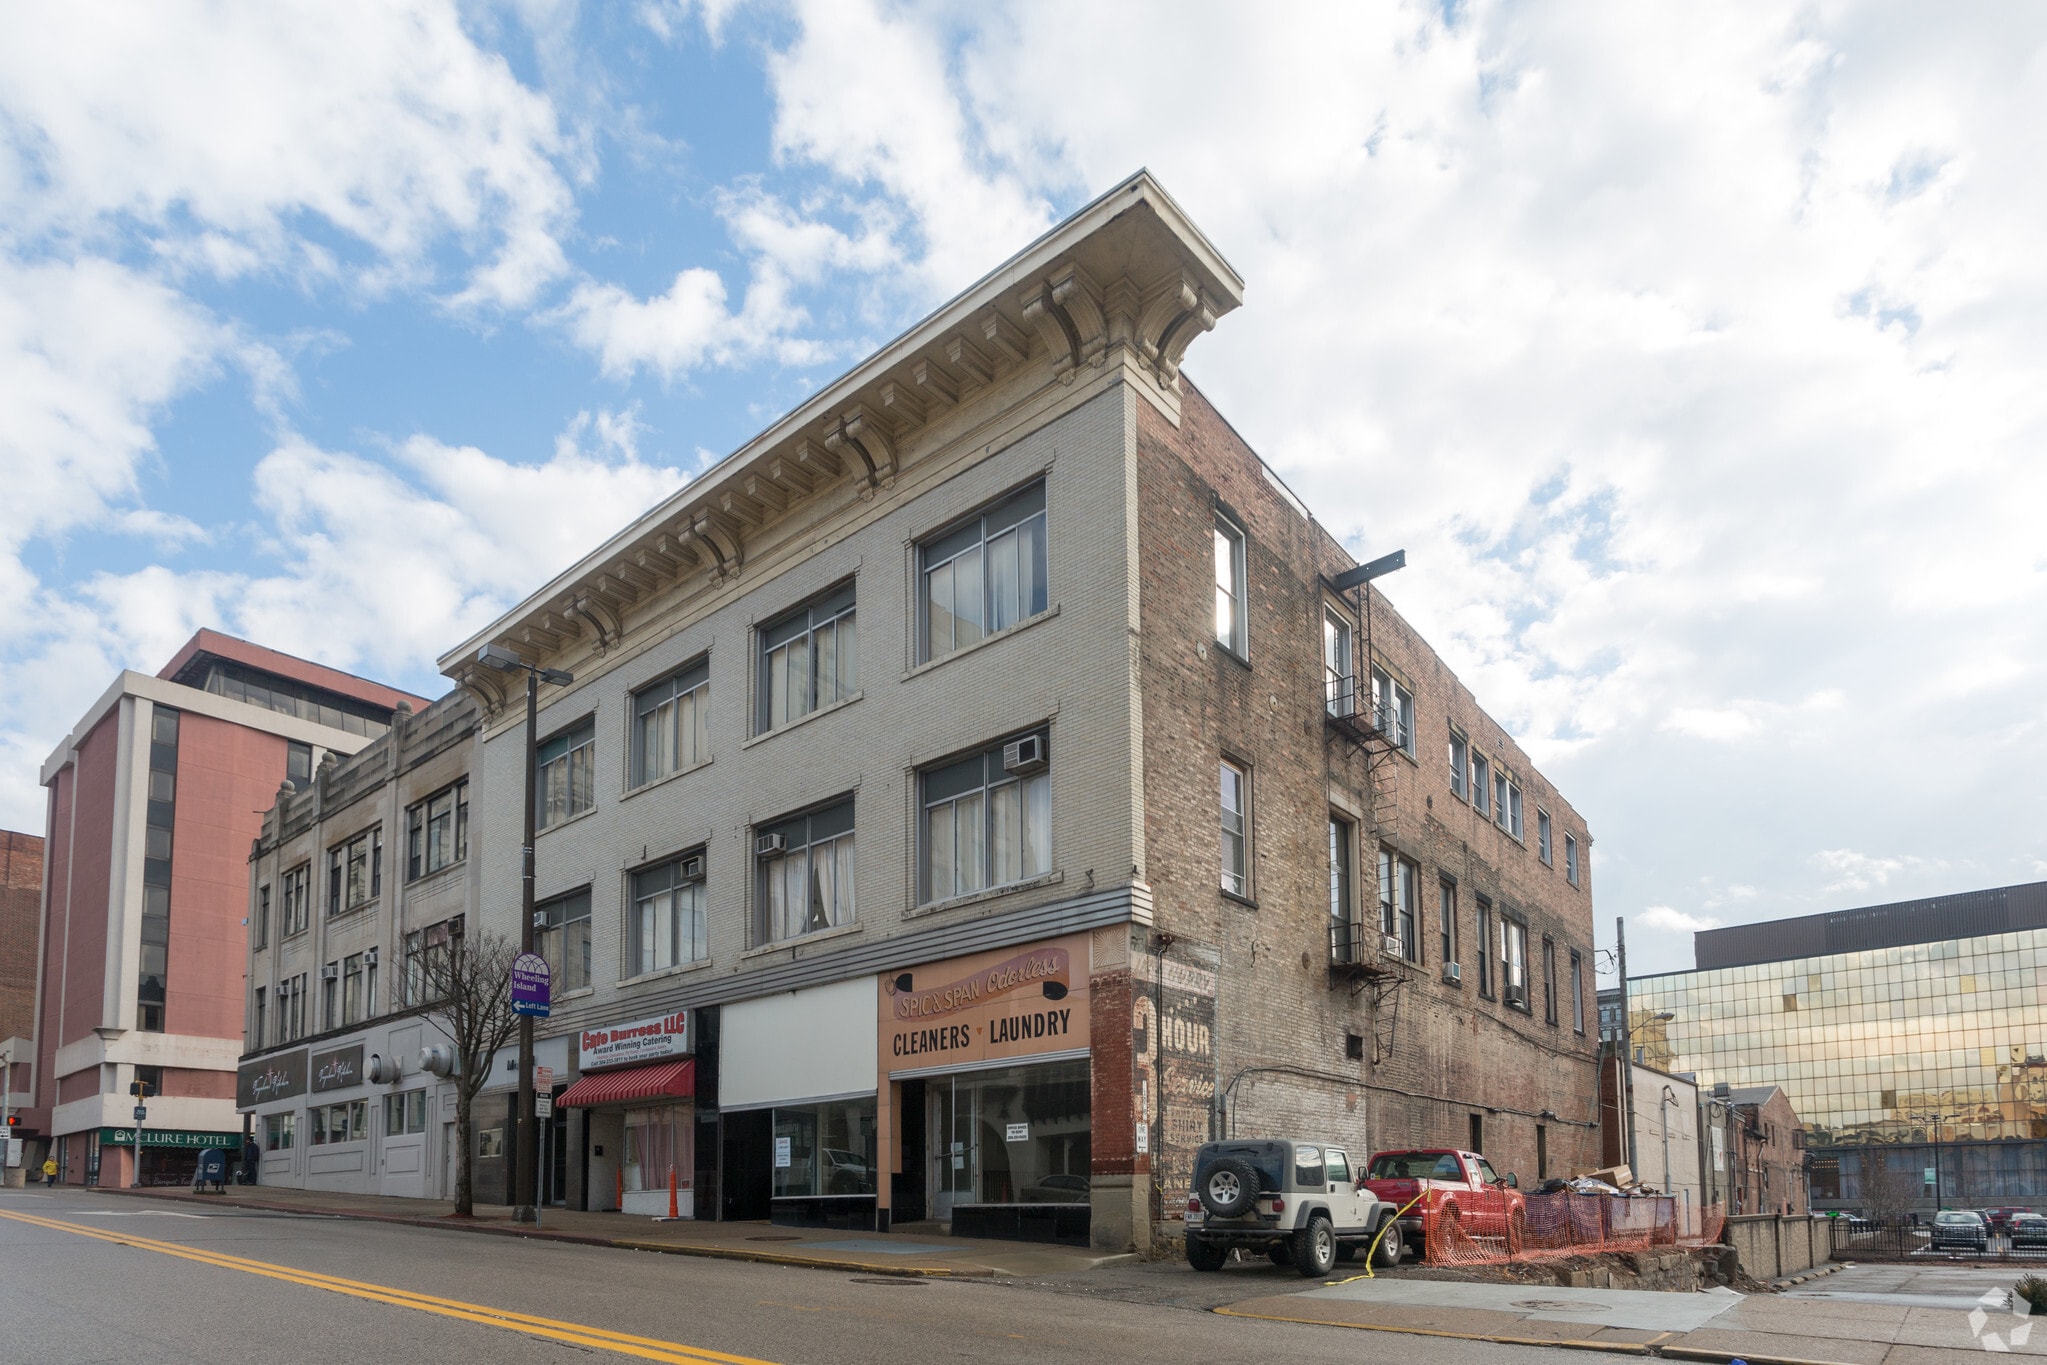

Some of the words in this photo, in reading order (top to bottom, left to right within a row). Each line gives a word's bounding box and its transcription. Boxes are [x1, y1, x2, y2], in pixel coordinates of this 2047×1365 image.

[513, 970, 549, 986] Wheeling
[513, 980, 537, 992] Island
[899, 995, 930, 1017] SPIC
[943, 979, 980, 1010] SPAN
[985, 956, 1061, 994] Odorless
[537, 1003, 549, 1011] Lane
[582, 1031, 608, 1052] Cafe
[610, 1022, 662, 1042] Burress
[663, 1012, 685, 1034] LLC
[893, 1023, 970, 1056] CLEANERS
[990, 1008, 1071, 1044] LAUNDRY
[1161, 1015, 1210, 1056] HOUR
[593, 1044, 614, 1055] Award
[615, 1039, 641, 1050] Winning
[642, 1034, 672, 1046] Catering
[1162, 1066, 1215, 1098] Service
[1138, 1125, 1146, 1134] ONE
[1172, 1119, 1202, 1132] SHIRT
[186, 1134, 231, 1146] HOTEL
[1138, 1135, 1146, 1143] WAY
[1170, 1133, 1204, 1144] SERVICE
